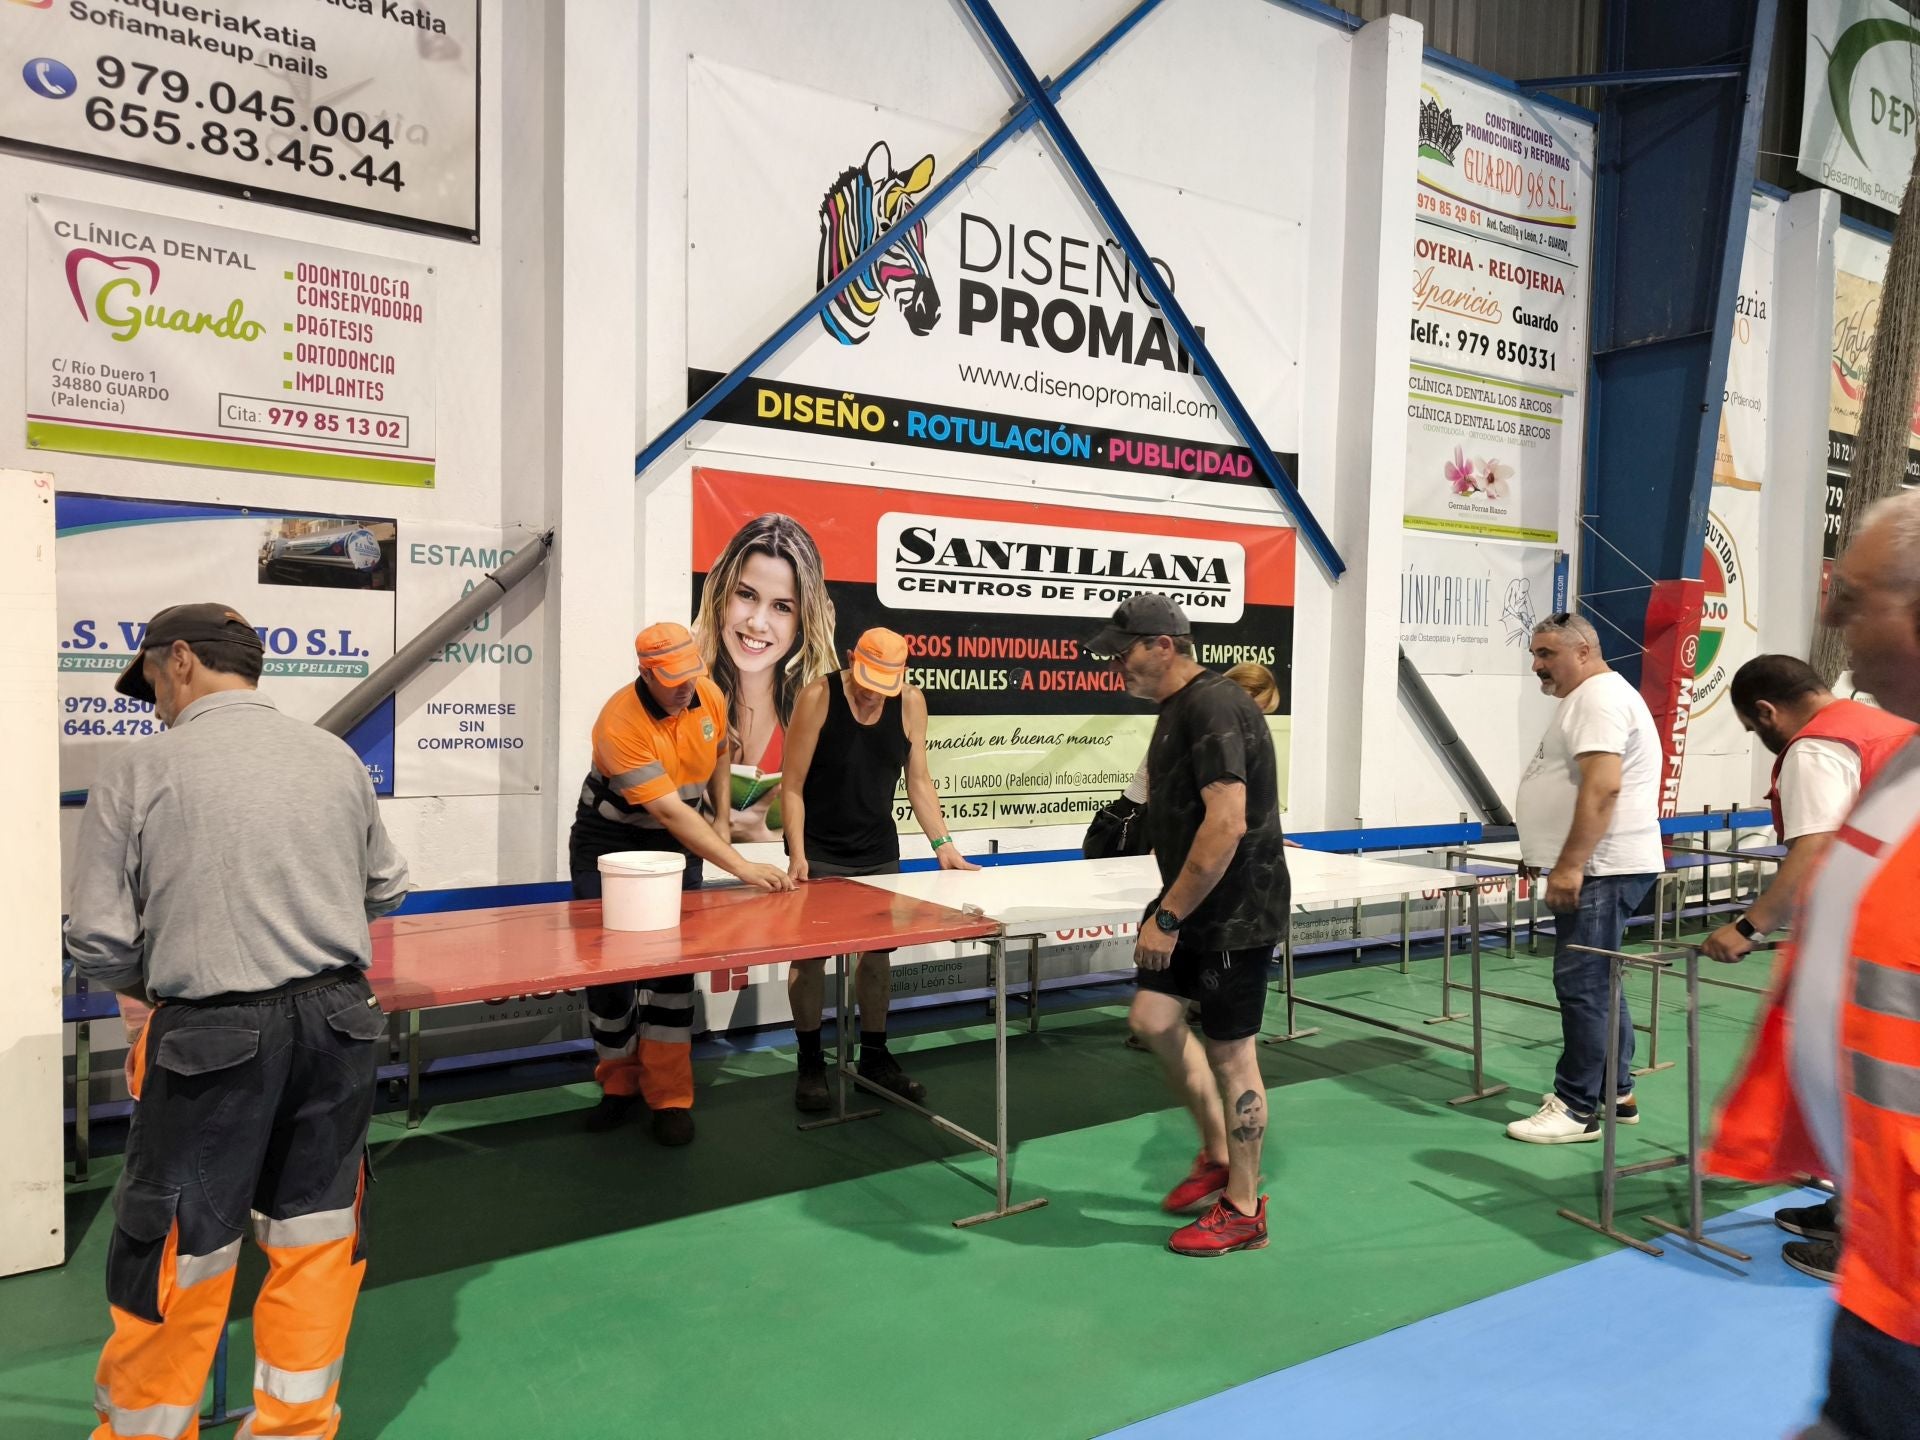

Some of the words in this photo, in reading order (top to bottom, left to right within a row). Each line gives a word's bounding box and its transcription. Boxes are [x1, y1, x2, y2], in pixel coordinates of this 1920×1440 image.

[382, 0, 447, 35] Katia
[69, 0, 329, 79] Sofiamakeup_nails
[95, 54, 395, 150] 979.045.004
[84, 95, 405, 192] 655.83.45.44
[1465, 122, 1522, 155] PROMOCIONES
[1530, 146, 1570, 171] REFORMAS
[1485, 111, 1553, 148] CONSTRUCCIONES
[1464, 147, 1523, 197] GUARDO
[1527, 171, 1544, 208] 98
[1548, 175, 1572, 212] S.L.
[1823, 162, 1872, 196] Desarrollos
[1417, 192, 1436, 212] 979
[1439, 198, 1451, 217] 85
[1455, 204, 1467, 222] 29
[1470, 209, 1481, 226] 61
[1548, 235, 1568, 253] GUARDO
[53, 219, 156, 253] CLÍNICA
[163, 238, 257, 271] DENTAL
[959, 211, 1176, 309] DISEÑO
[1413, 238, 1474, 271] OYERIA
[1489, 258, 1565, 295] RELOJERIA
[95, 277, 266, 342] Guardo
[296, 284, 423, 324] CONSERVADORA
[1412, 265, 1503, 319] Aparicio
[1735, 290, 1767, 320] aria
[1512, 305, 1559, 333] Guardo
[296, 342, 396, 375] ORTODONCIA
[1457, 329, 1490, 356] 979
[1496, 339, 1556, 372] 850331
[51, 357, 68, 372] C/
[71, 360, 96, 376] Río
[100, 364, 145, 383] Duero
[149, 370, 156, 384] 1
[51, 374, 102, 393] 34880
[106, 381, 170, 401] GUARDO
[296, 371, 384, 402] IMPLANTES
[51, 391, 126, 415] (Palencia)
[958, 363, 1219, 420] www.disenopromail.com
[1408, 376, 1453, 396] CLÍNICA
[1456, 385, 1496, 404] DENTAL
[1498, 393, 1518, 408] LOS
[1519, 397, 1553, 414] ARCOS
[226, 404, 262, 423] Cita:
[268, 407, 309, 428] 979
[314, 412, 340, 432] 85
[346, 416, 371, 436] 13
[375, 420, 401, 439] 02
[756, 389, 886, 433] DISEÑO
[907, 410, 1092, 459] ROTULACIÓN
[1108, 437, 1254, 479] PUBLICIDAD
[1407, 404, 1452, 424] CLÍNICA
[1454, 412, 1495, 431] DENTAL
[1497, 419, 1516, 434] LOS
[1518, 424, 1551, 440] ARCOS
[895, 526, 1231, 585] SANTILLANA
[897, 576, 1033, 599] CENTROS
[1041, 584, 1075, 601] DE
[305, 628, 370, 658] S.L.
[905, 634, 952, 658] RSOS
[957, 636, 1078, 660] INDIVIDUALES
[1202, 644, 1275, 666] EMPRESAS
[298, 662, 363, 674] PELLETS
[904, 667, 1008, 691] ESENCIALES
[1020, 671, 1034, 690] A
[1039, 671, 1126, 692] DISTANCIA
[1692, 665, 1726, 703] alencia)
[426, 702, 516, 715] INFORMESE
[458, 720, 485, 732] SIN
[417, 737, 524, 750] COMPROMISO
[988, 735, 1007, 746] en
[1010, 727, 1065, 746] buenas
[1066, 734, 1114, 748] manos
[1659, 677, 1695, 818] MAPFRE
[960, 775, 1003, 790] GUARDO
[1005, 772, 1053, 789] (Palencia)
[921, 961, 963, 975] Porcinos
